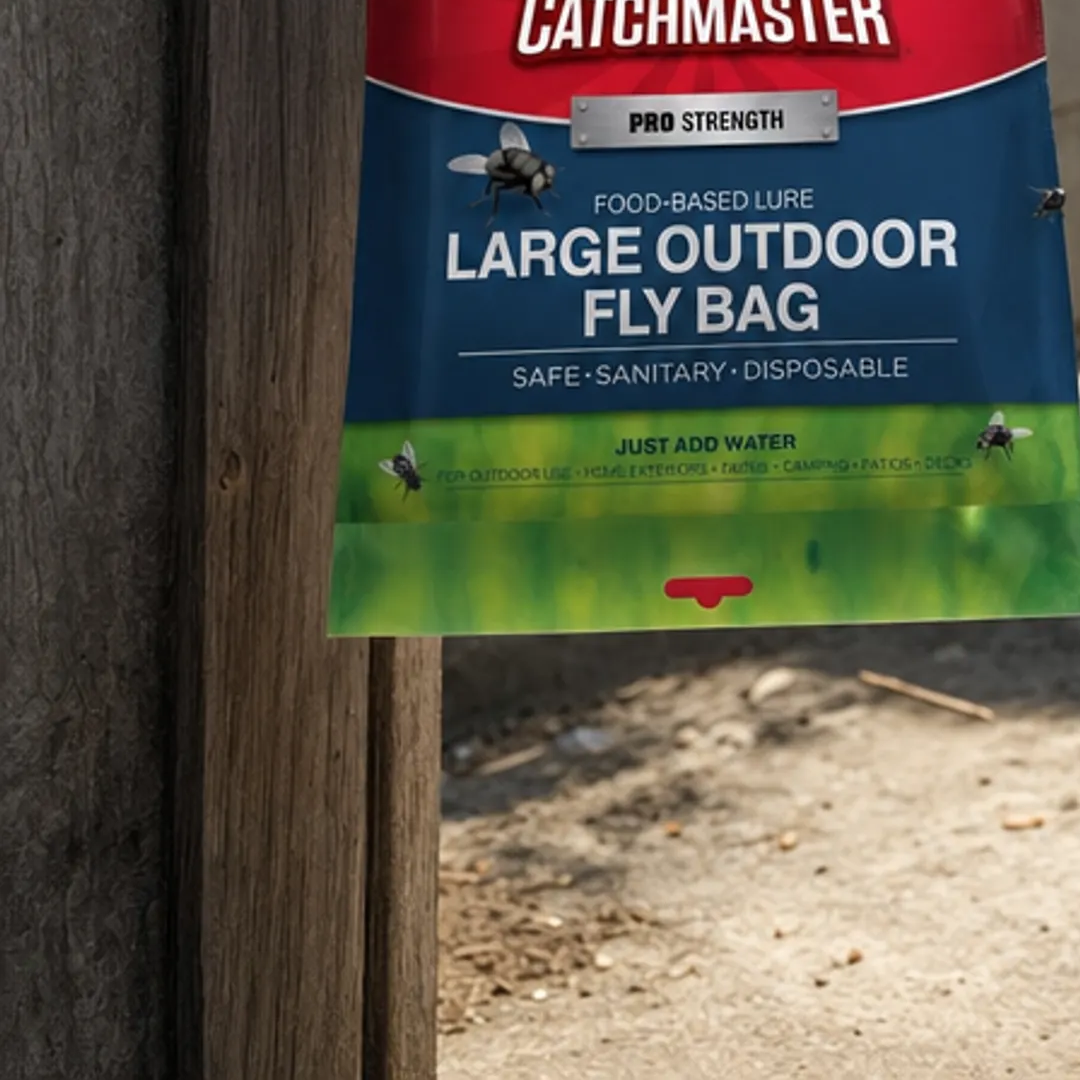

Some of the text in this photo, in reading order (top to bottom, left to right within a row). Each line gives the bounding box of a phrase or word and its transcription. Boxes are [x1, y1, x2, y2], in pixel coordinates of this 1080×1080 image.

[629, 109, 785, 134] PRO STRENGTH
[594, 188, 815, 215] FOOD-BASED LURE
[446, 218, 959, 280] LARGE OUTDOOR
[584, 283, 820, 337] FLY BAG
[512, 356, 909, 388] SAFE SANITARY DISPOSABLE
[614, 432, 797, 456] JUST ADD WATER
